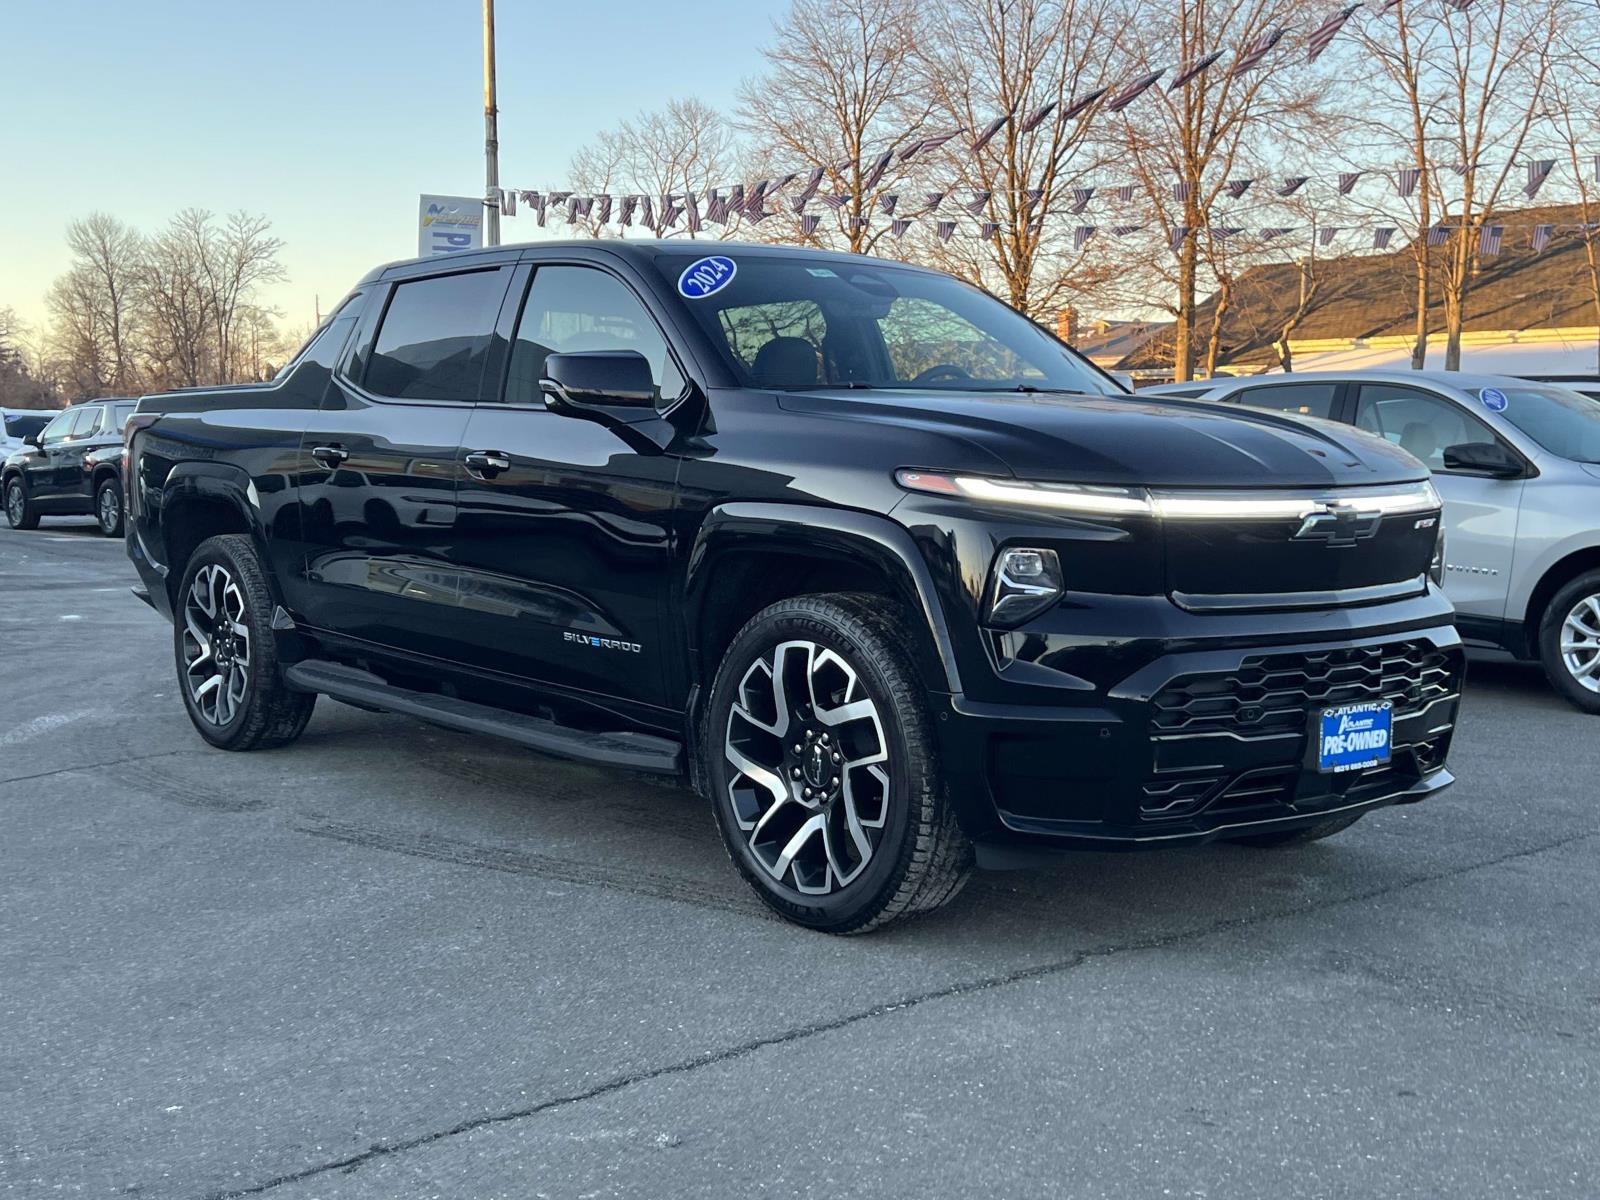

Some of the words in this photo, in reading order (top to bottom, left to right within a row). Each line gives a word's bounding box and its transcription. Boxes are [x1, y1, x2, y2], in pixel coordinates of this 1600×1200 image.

[687, 258, 729, 294] 2024
[563, 631, 642, 653] SILVERADO
[1337, 703, 1378, 715] ATLANTIC
[1323, 729, 1387, 756] PRE-OWNED
